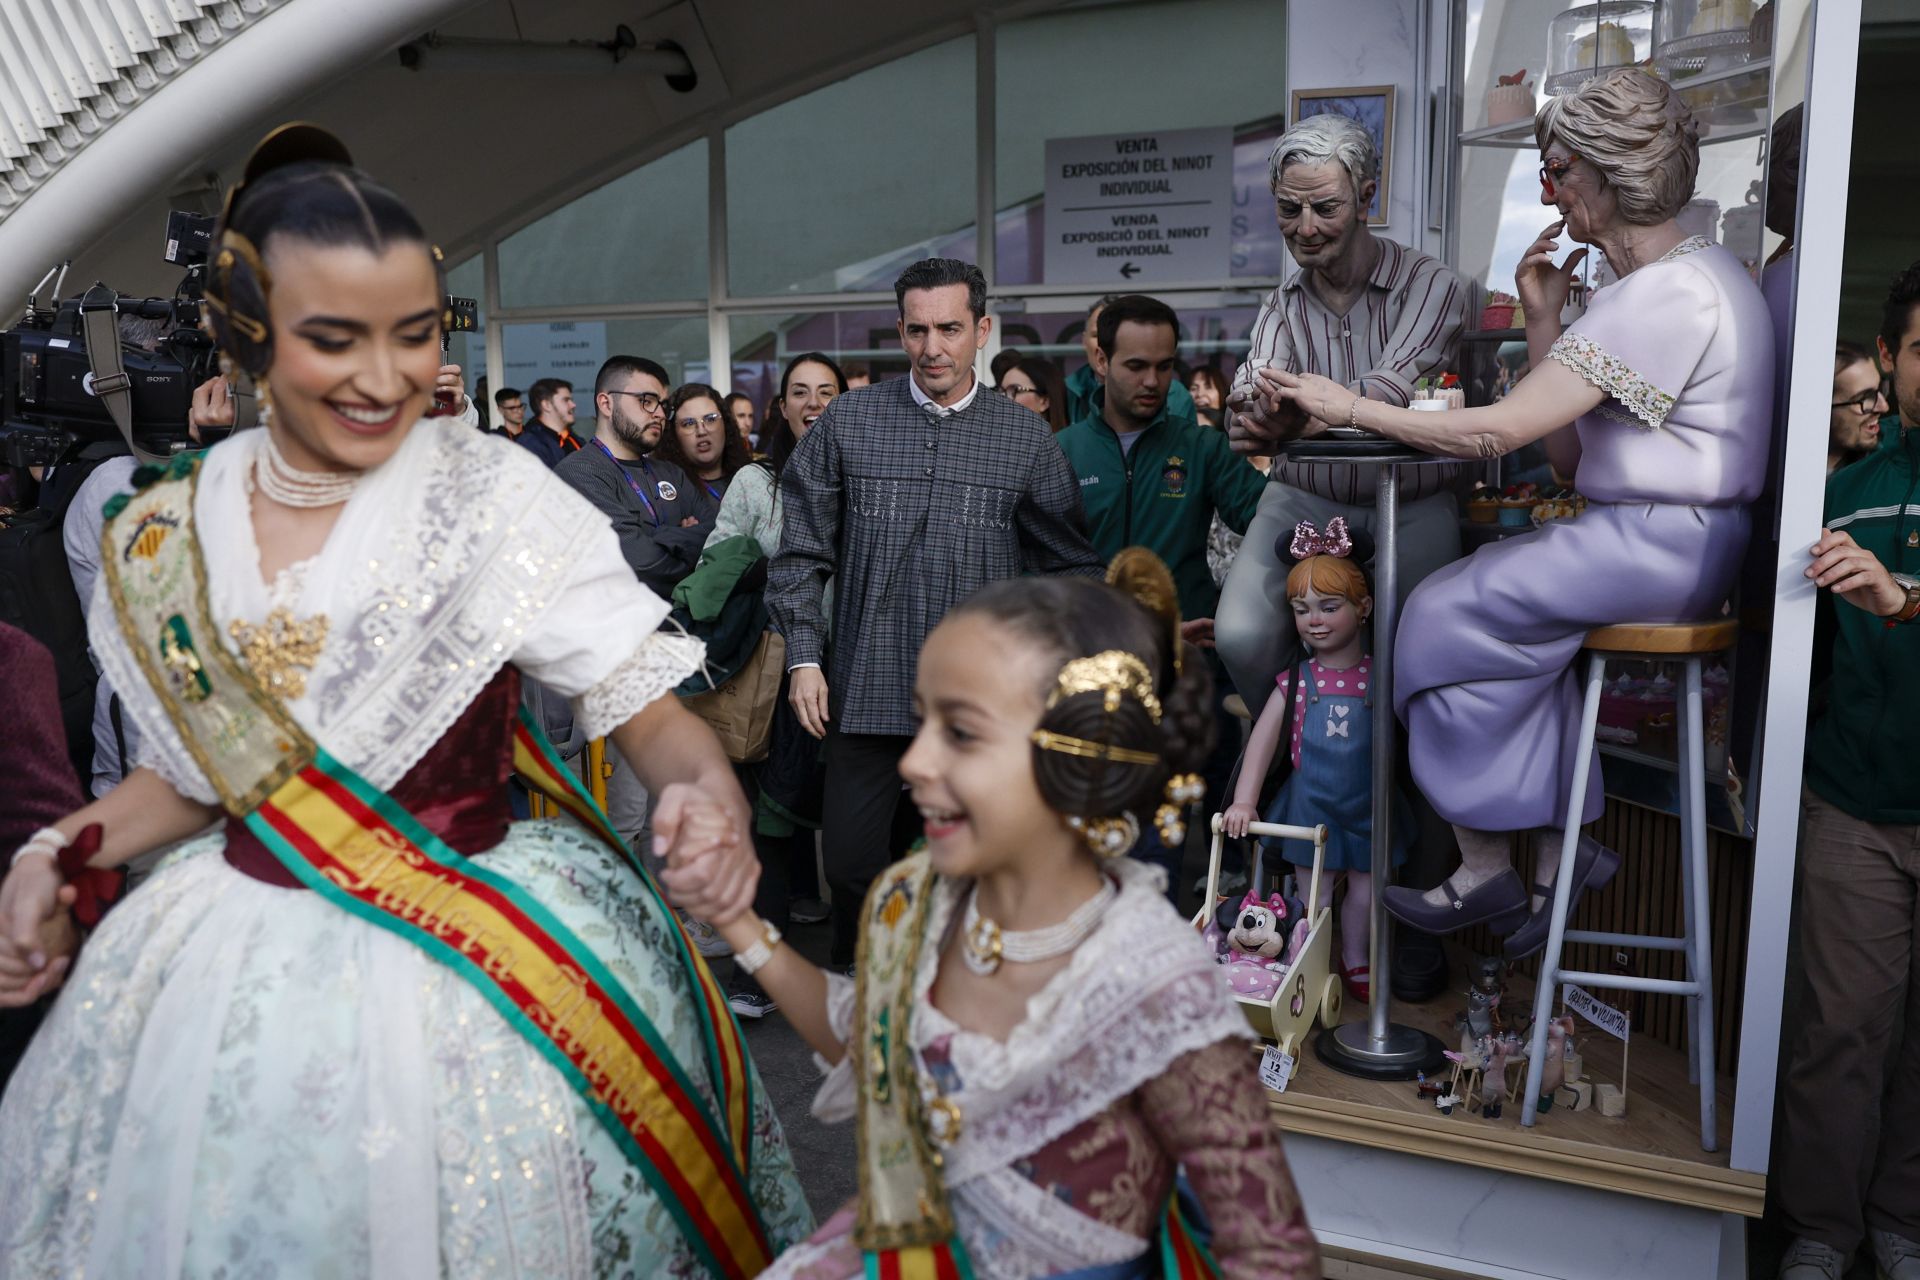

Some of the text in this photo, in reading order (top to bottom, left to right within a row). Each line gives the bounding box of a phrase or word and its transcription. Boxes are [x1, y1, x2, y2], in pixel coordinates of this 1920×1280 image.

[1116, 138, 1158, 154] VENTA
[1062, 155, 1214, 179] EXPOSICIÓN DEL NINOT
[1100, 179, 1172, 196] INDIVIDUAL
[1111, 214, 1158, 227] VENDA
[193, 230, 211, 239] PRO-X
[1062, 227, 1210, 244] EXPOSICIÓ DEL NINOT
[1097, 244, 1173, 258] INDIVIDUAL
[319, 826, 518, 985] Fallera
[1270, 1061, 1281, 1073] 12
